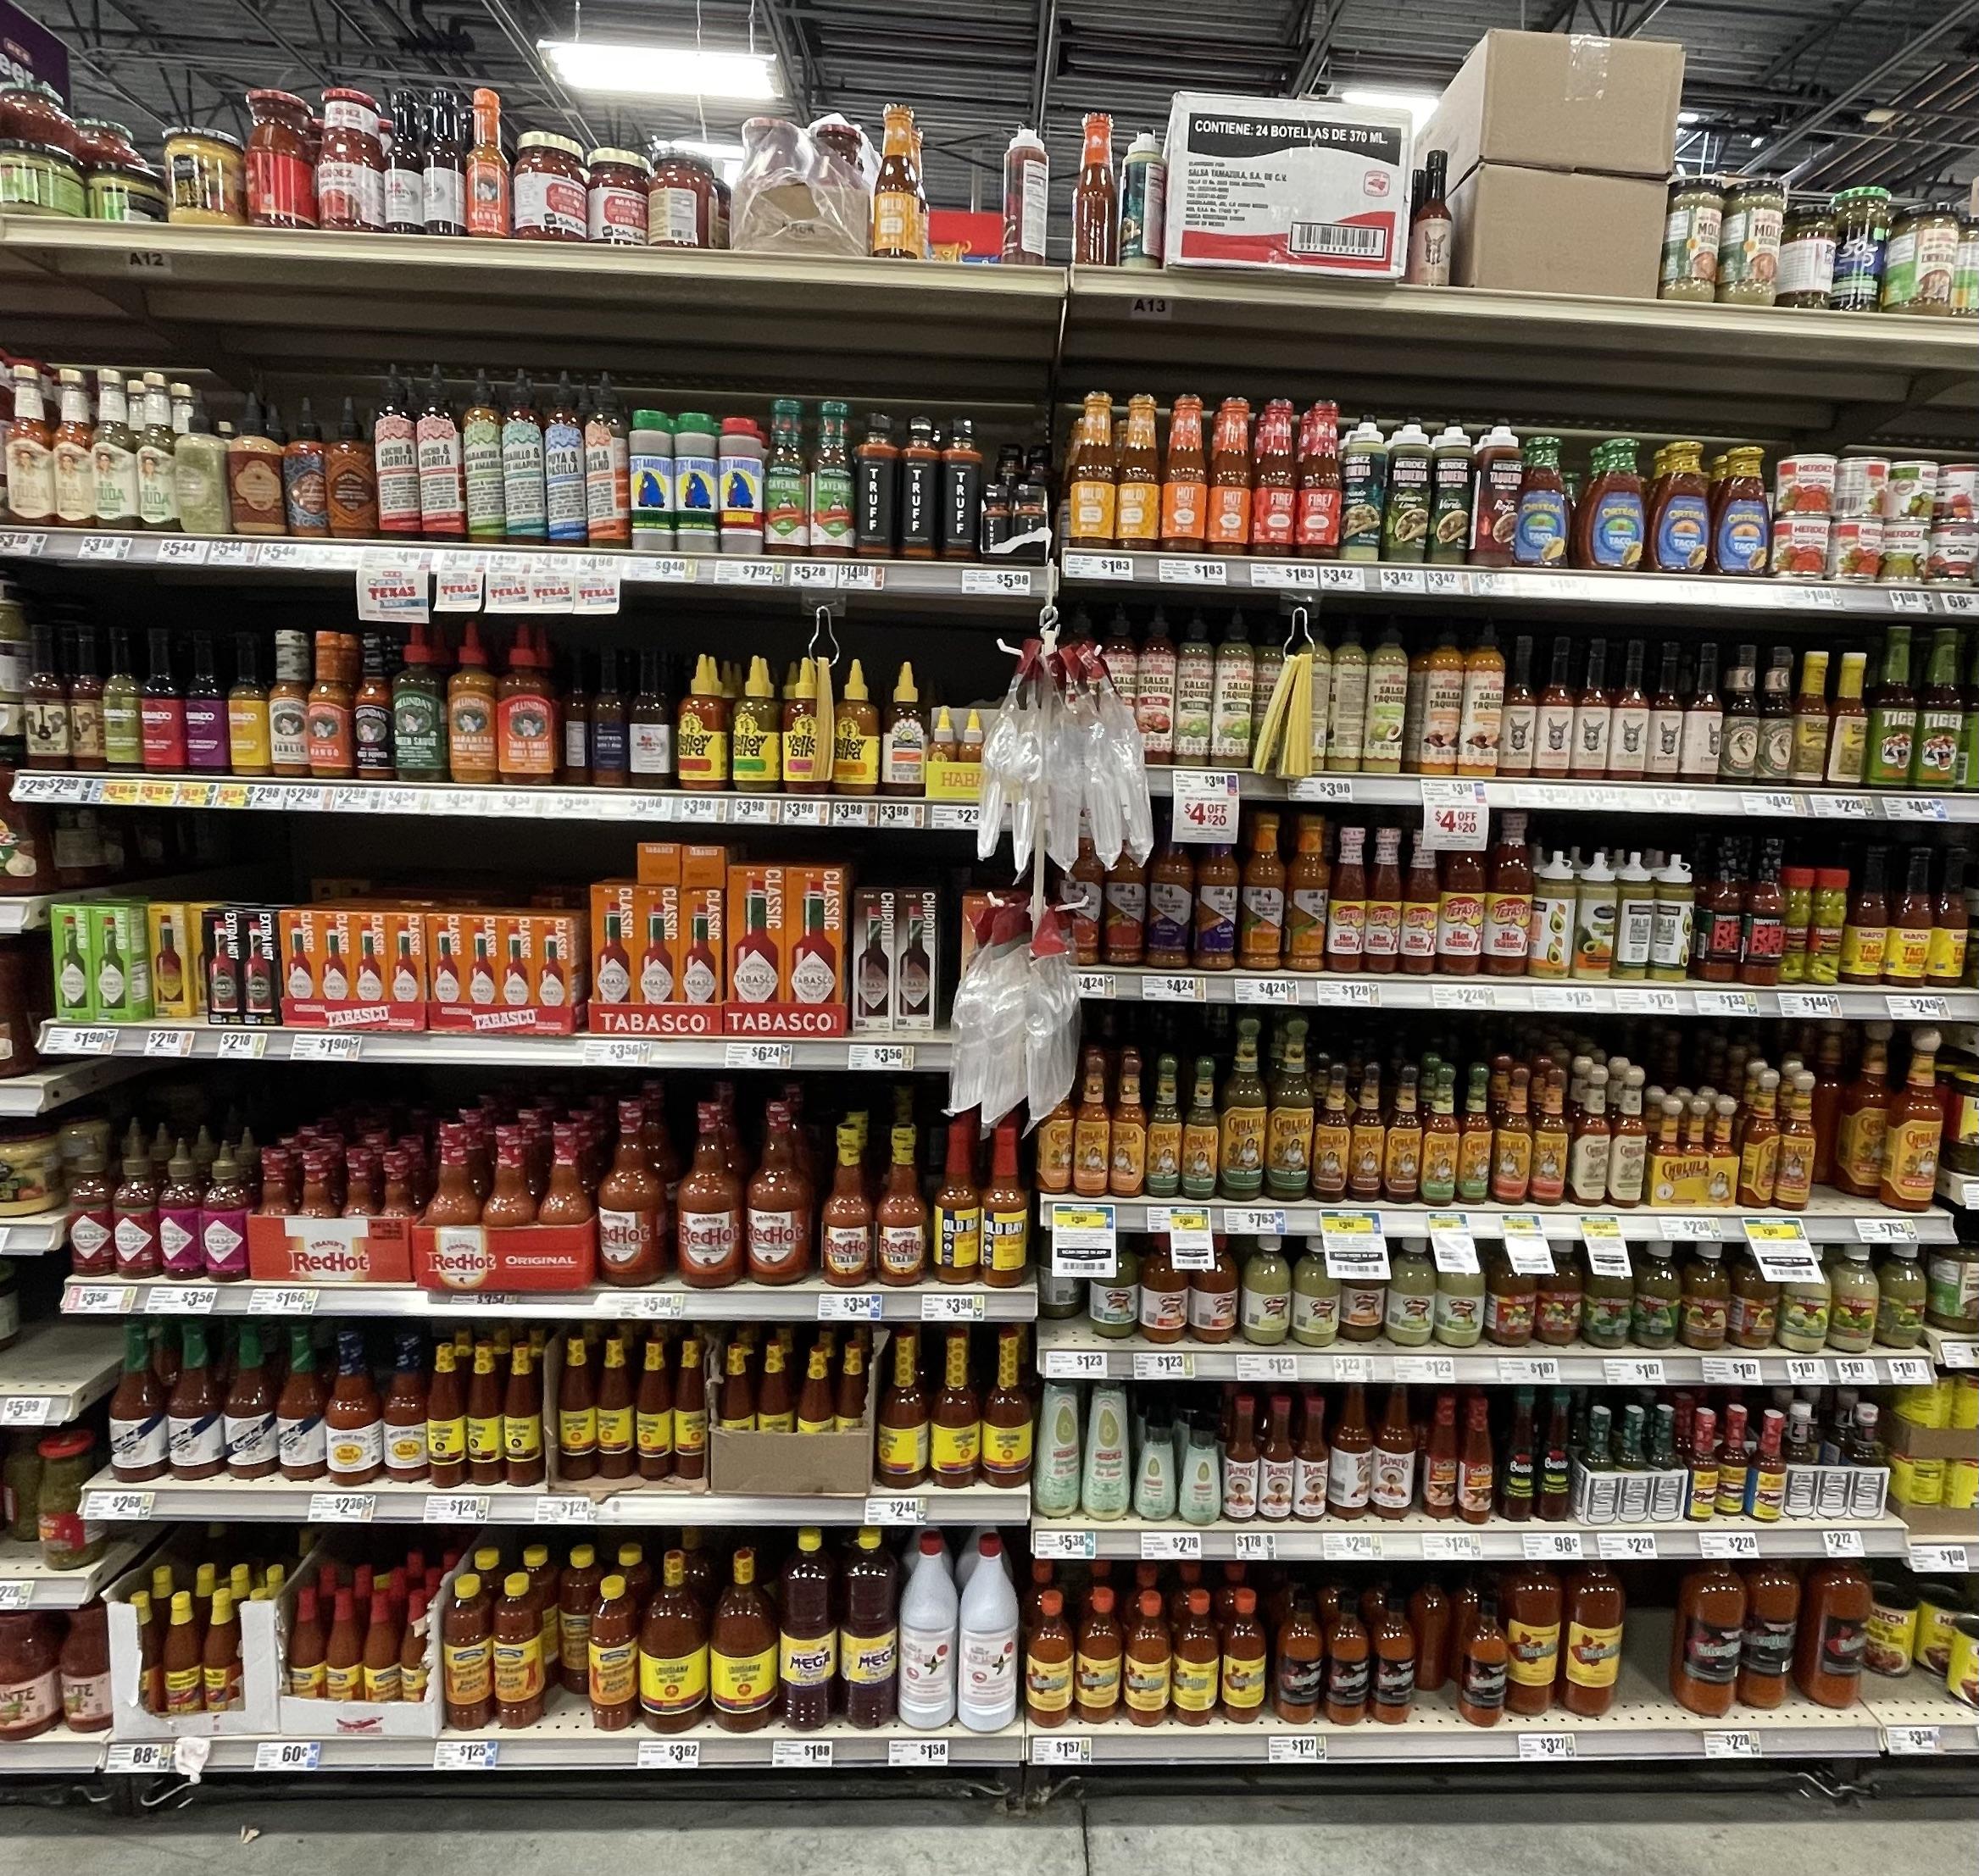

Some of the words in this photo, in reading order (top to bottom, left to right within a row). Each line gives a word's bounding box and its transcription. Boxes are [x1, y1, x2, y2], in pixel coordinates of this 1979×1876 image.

[1194, 119, 1253, 136] CONTIENE:
[1255, 125, 1270, 137] 24
[1270, 125, 1330, 142] BOTELLAS
[1331, 129, 1348, 142] DE
[1349, 130, 1367, 143] 370
[1369, 133, 1387, 145] ML.
[131, 253, 164, 266] A12
[1134, 299, 1165, 312] A13
[868, 467, 879, 532] TRUFF
[911, 469, 922, 533] TRUFF
[955, 470, 965, 535] TRUFF
[1176, 486, 1196, 500] HOT
[1223, 491, 1242, 505] HOT
[368, 586, 416, 599] TEXAS
[441, 583, 478, 595] TEXAS
[490, 586, 526, 599] TEXAS
[534, 586, 570, 598] TEXAS
[579, 588, 615, 600] TEXAS
[1184, 802, 1206, 824] $4
[1207, 804, 1227, 814] OFF
[1208, 814, 1227, 826] $20
[1435, 809, 1456, 832] $4
[1457, 812, 1477, 821] OFF
[1458, 821, 1477, 833] $20
[765, 869, 781, 930] CLASSIC
[824, 870, 840, 931] CLASSIC
[618, 887, 633, 940] CLASSIC
[662, 888, 677, 941] CLASSIC
[706, 889, 721, 941] CLASSIC
[225, 912, 237, 937] EXTRA
[259, 913, 270, 937] EXTRA
[447, 914, 461, 956] CLASSIC
[735, 974, 776, 985] TABASCO
[792, 974, 834, 985] TABASCO
[325, 1005, 389, 1027] TABASCO
[472, 1008, 536, 1030] TABASCO
[600, 1012, 705, 1033] TABASCO
[728, 1012, 832, 1032] TABASCO
[1661, 1160, 1709, 1179] CHOLULA
[984, 1220, 1004, 1235] OLD
[1004, 1221, 1024, 1235] BAY
[292, 1251, 369, 1271] RedHot
[430, 1252, 496, 1270] RedHot
[505, 1255, 577, 1265] ORIGINAL
